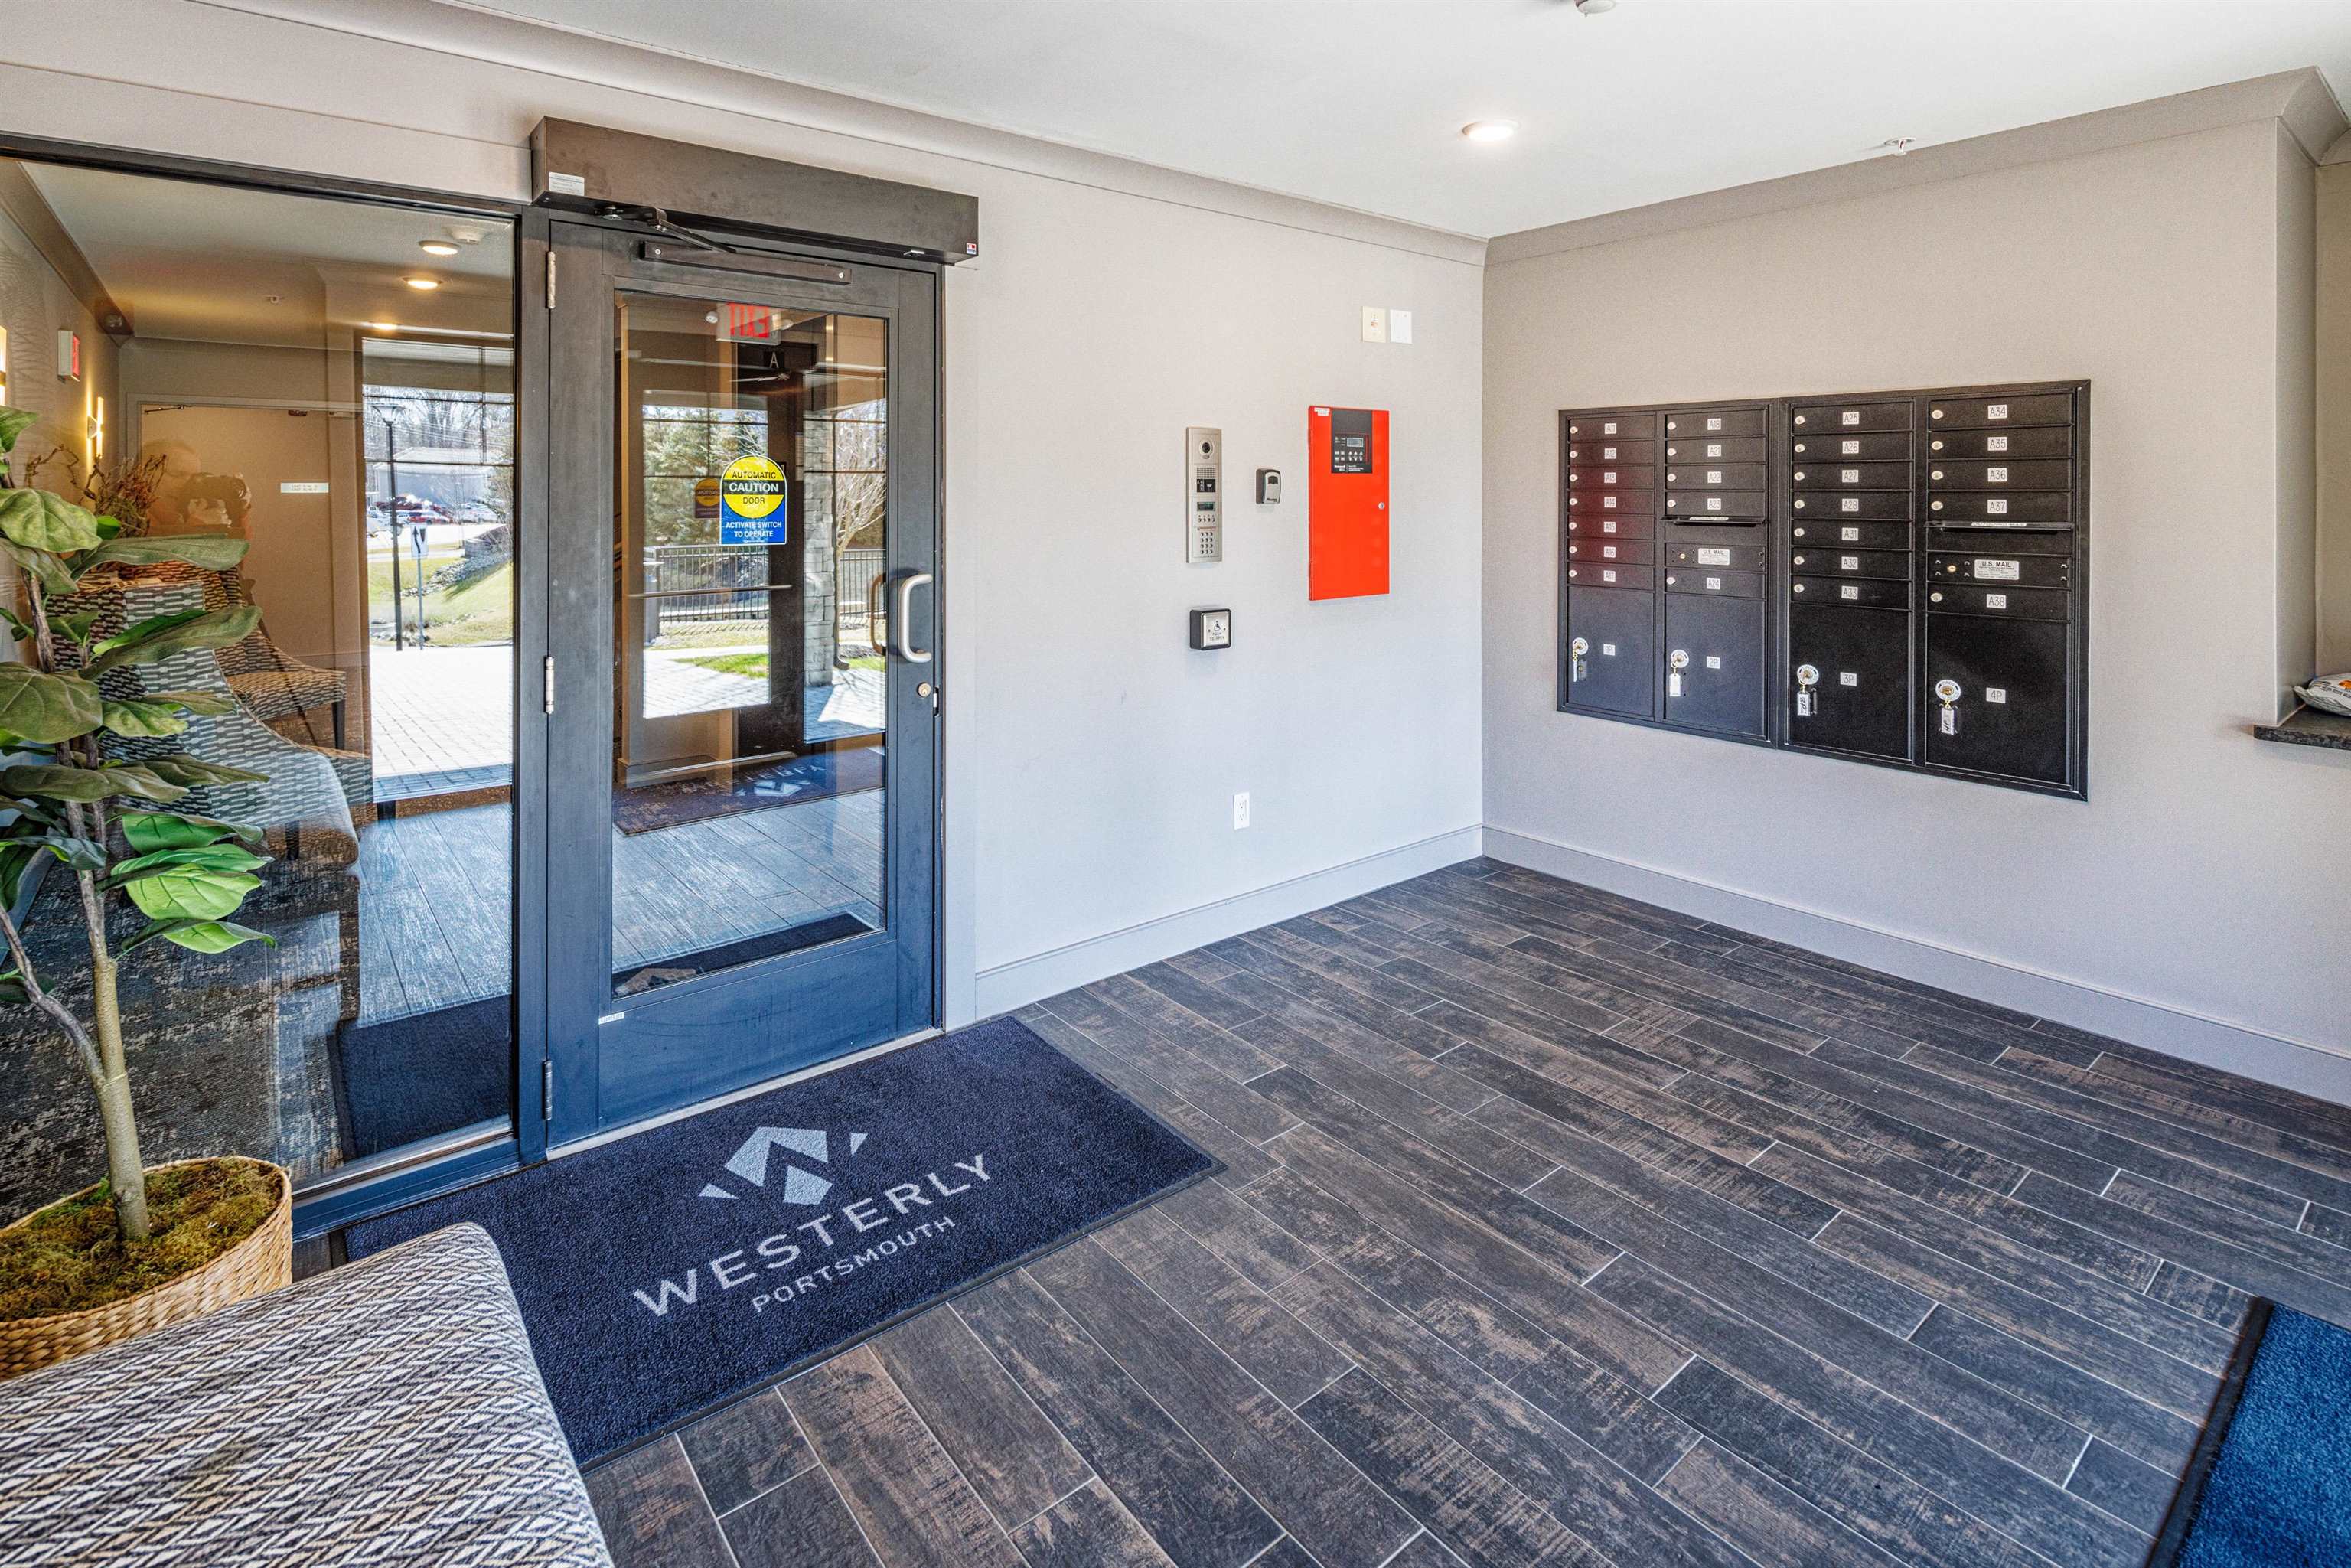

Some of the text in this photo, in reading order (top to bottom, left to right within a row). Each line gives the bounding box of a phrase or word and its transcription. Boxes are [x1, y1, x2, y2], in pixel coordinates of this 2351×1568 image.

[1989, 406, 2007, 418] A34
[1844, 412, 1858, 424] A25
[1844, 442, 1858, 452] A26
[1989, 438, 2007, 449] A35
[1709, 446, 1721, 456] A21
[1708, 472, 1721, 482] A22
[1843, 471, 1857, 481] A27
[1989, 469, 2007, 481] A36
[729, 482, 779, 492] CAUTION
[1843, 500, 1858, 510] A28
[1989, 500, 2006, 513] A37
[1843, 529, 1857, 540] A31
[1843, 558, 1857, 569] A32
[1843, 587, 1857, 598] A33
[1988, 595, 2005, 608] A38
[1843, 673, 1854, 684] 3P
[1990, 689, 2003, 701] 4P
[632, 1153, 990, 1316] WESTERLY
[751, 1215, 956, 1313] PORTSMOUTH
